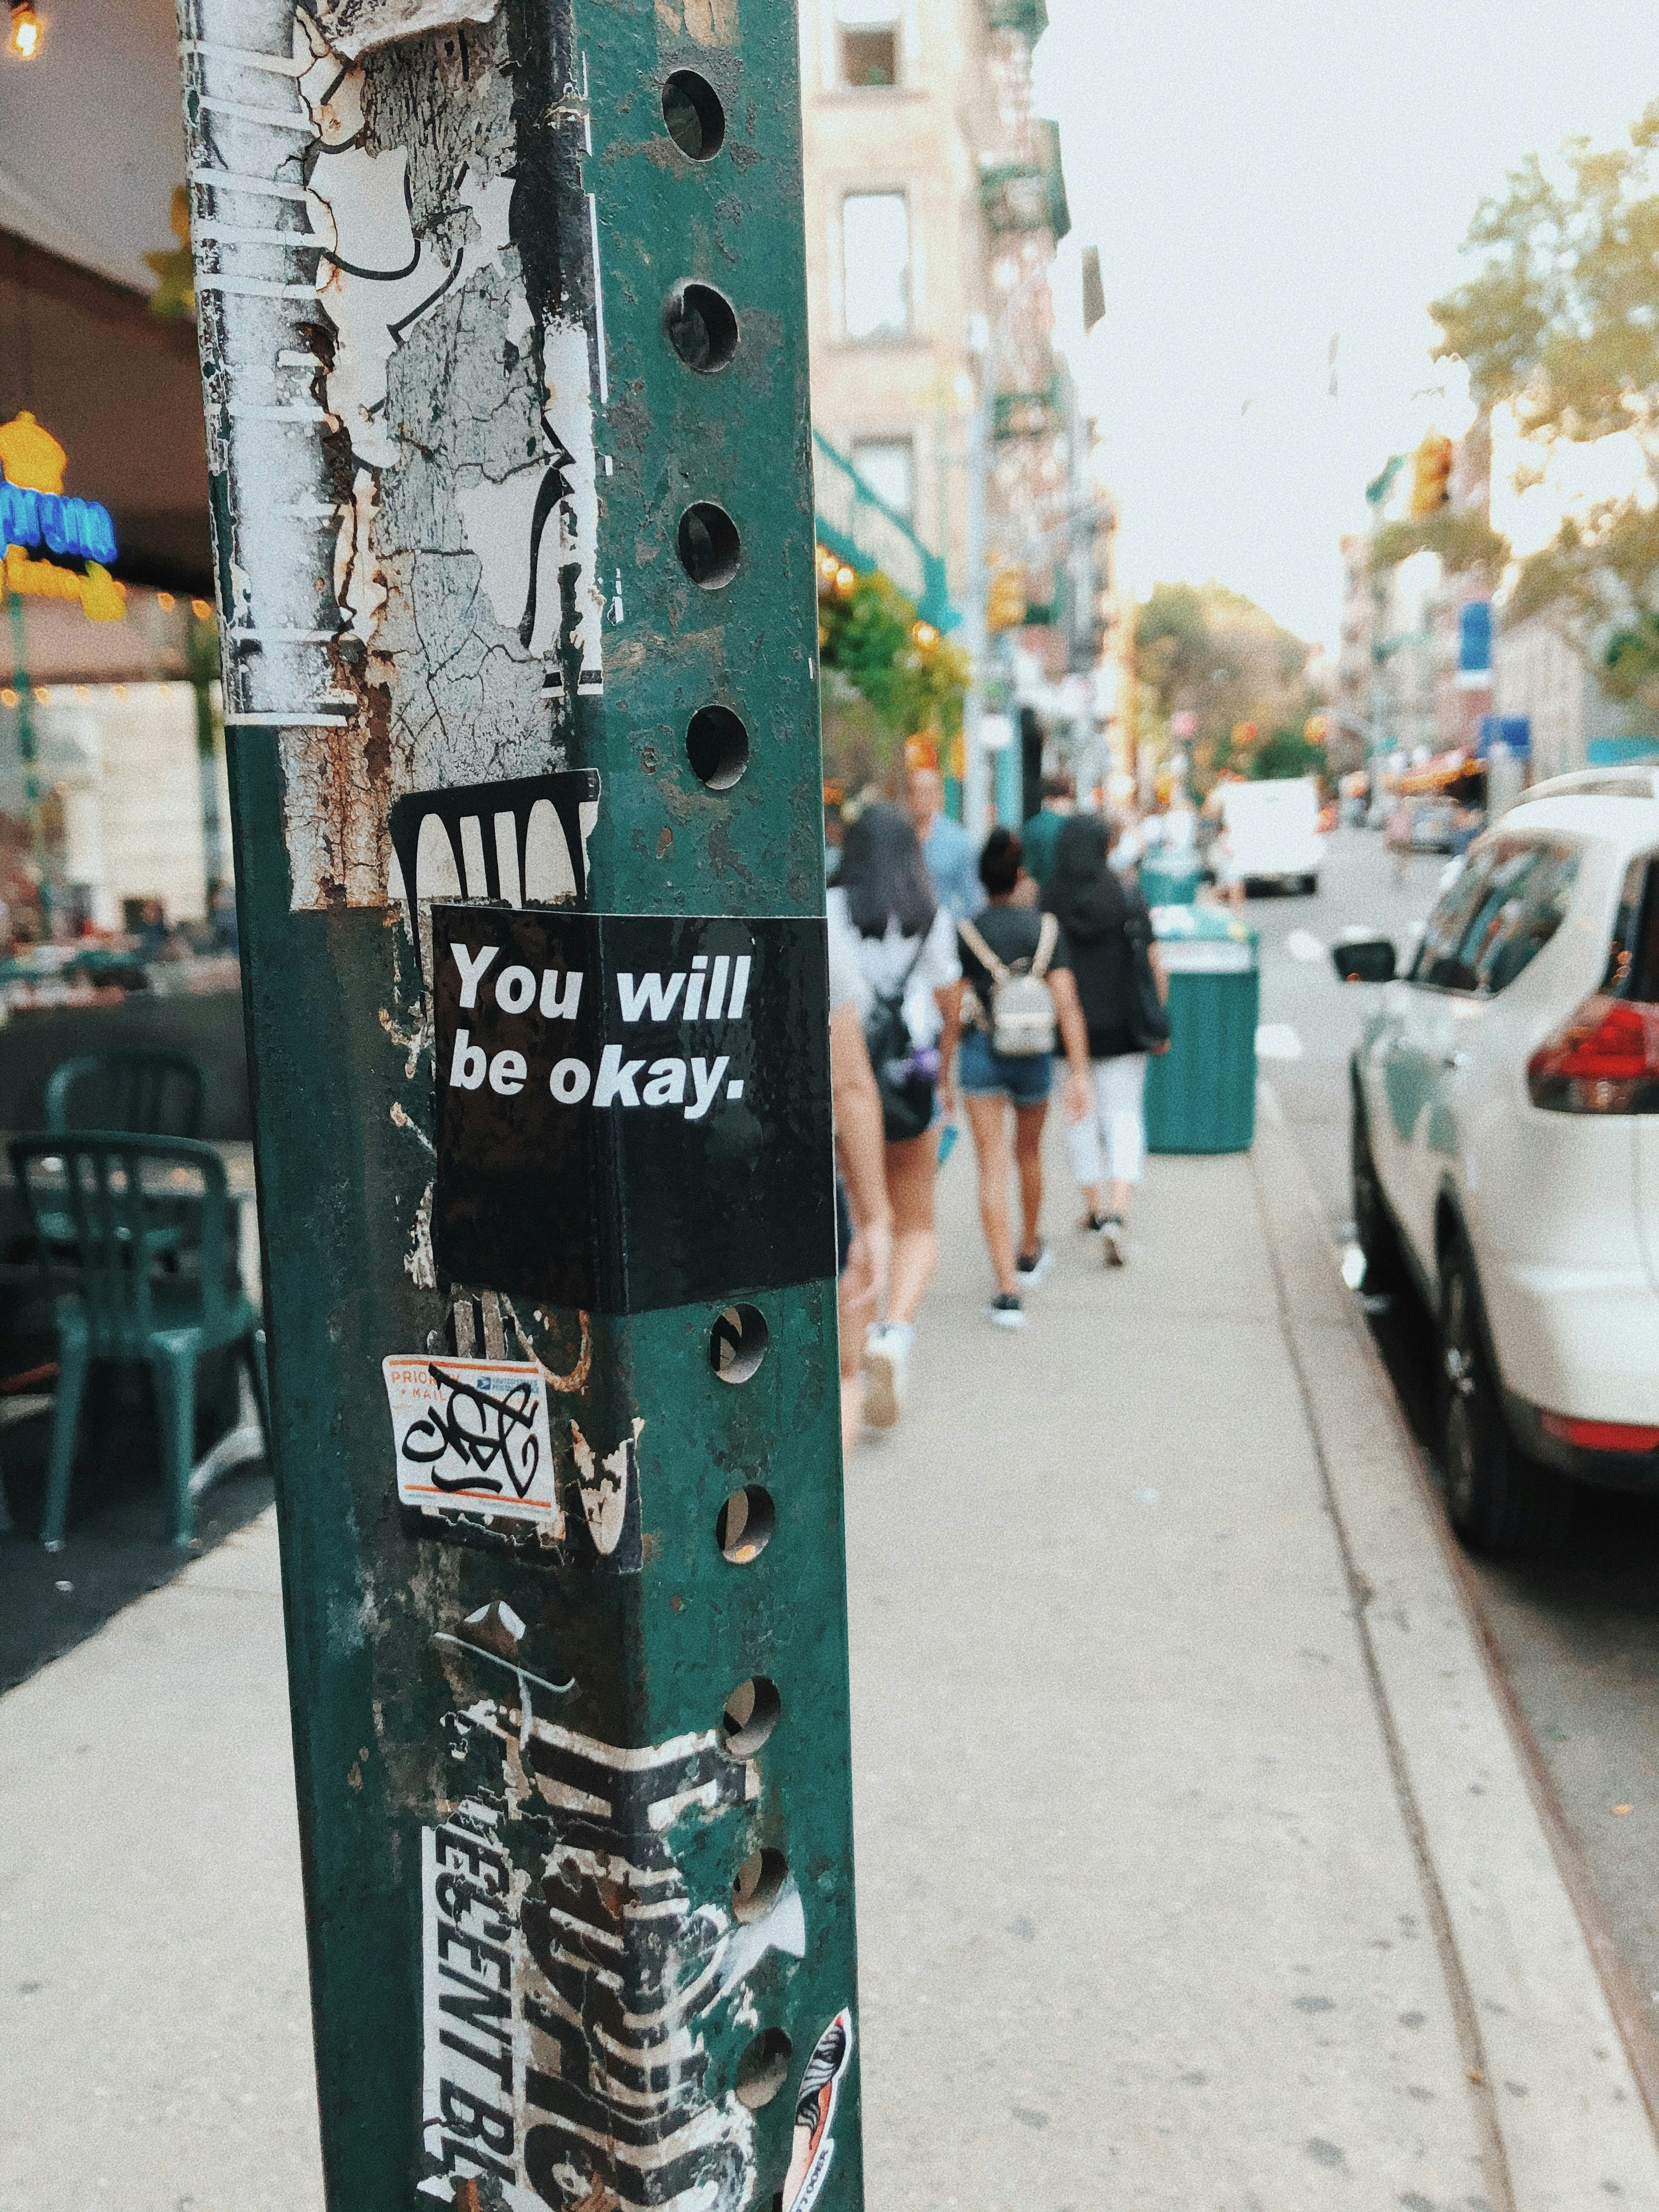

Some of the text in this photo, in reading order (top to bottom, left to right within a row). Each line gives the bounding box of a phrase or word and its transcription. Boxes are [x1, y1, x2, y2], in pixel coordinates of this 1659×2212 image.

[450, 943, 752, 1022] You will
[449, 1029, 744, 1120] be okay.
[413, 1387, 447, 1401] MAIL
